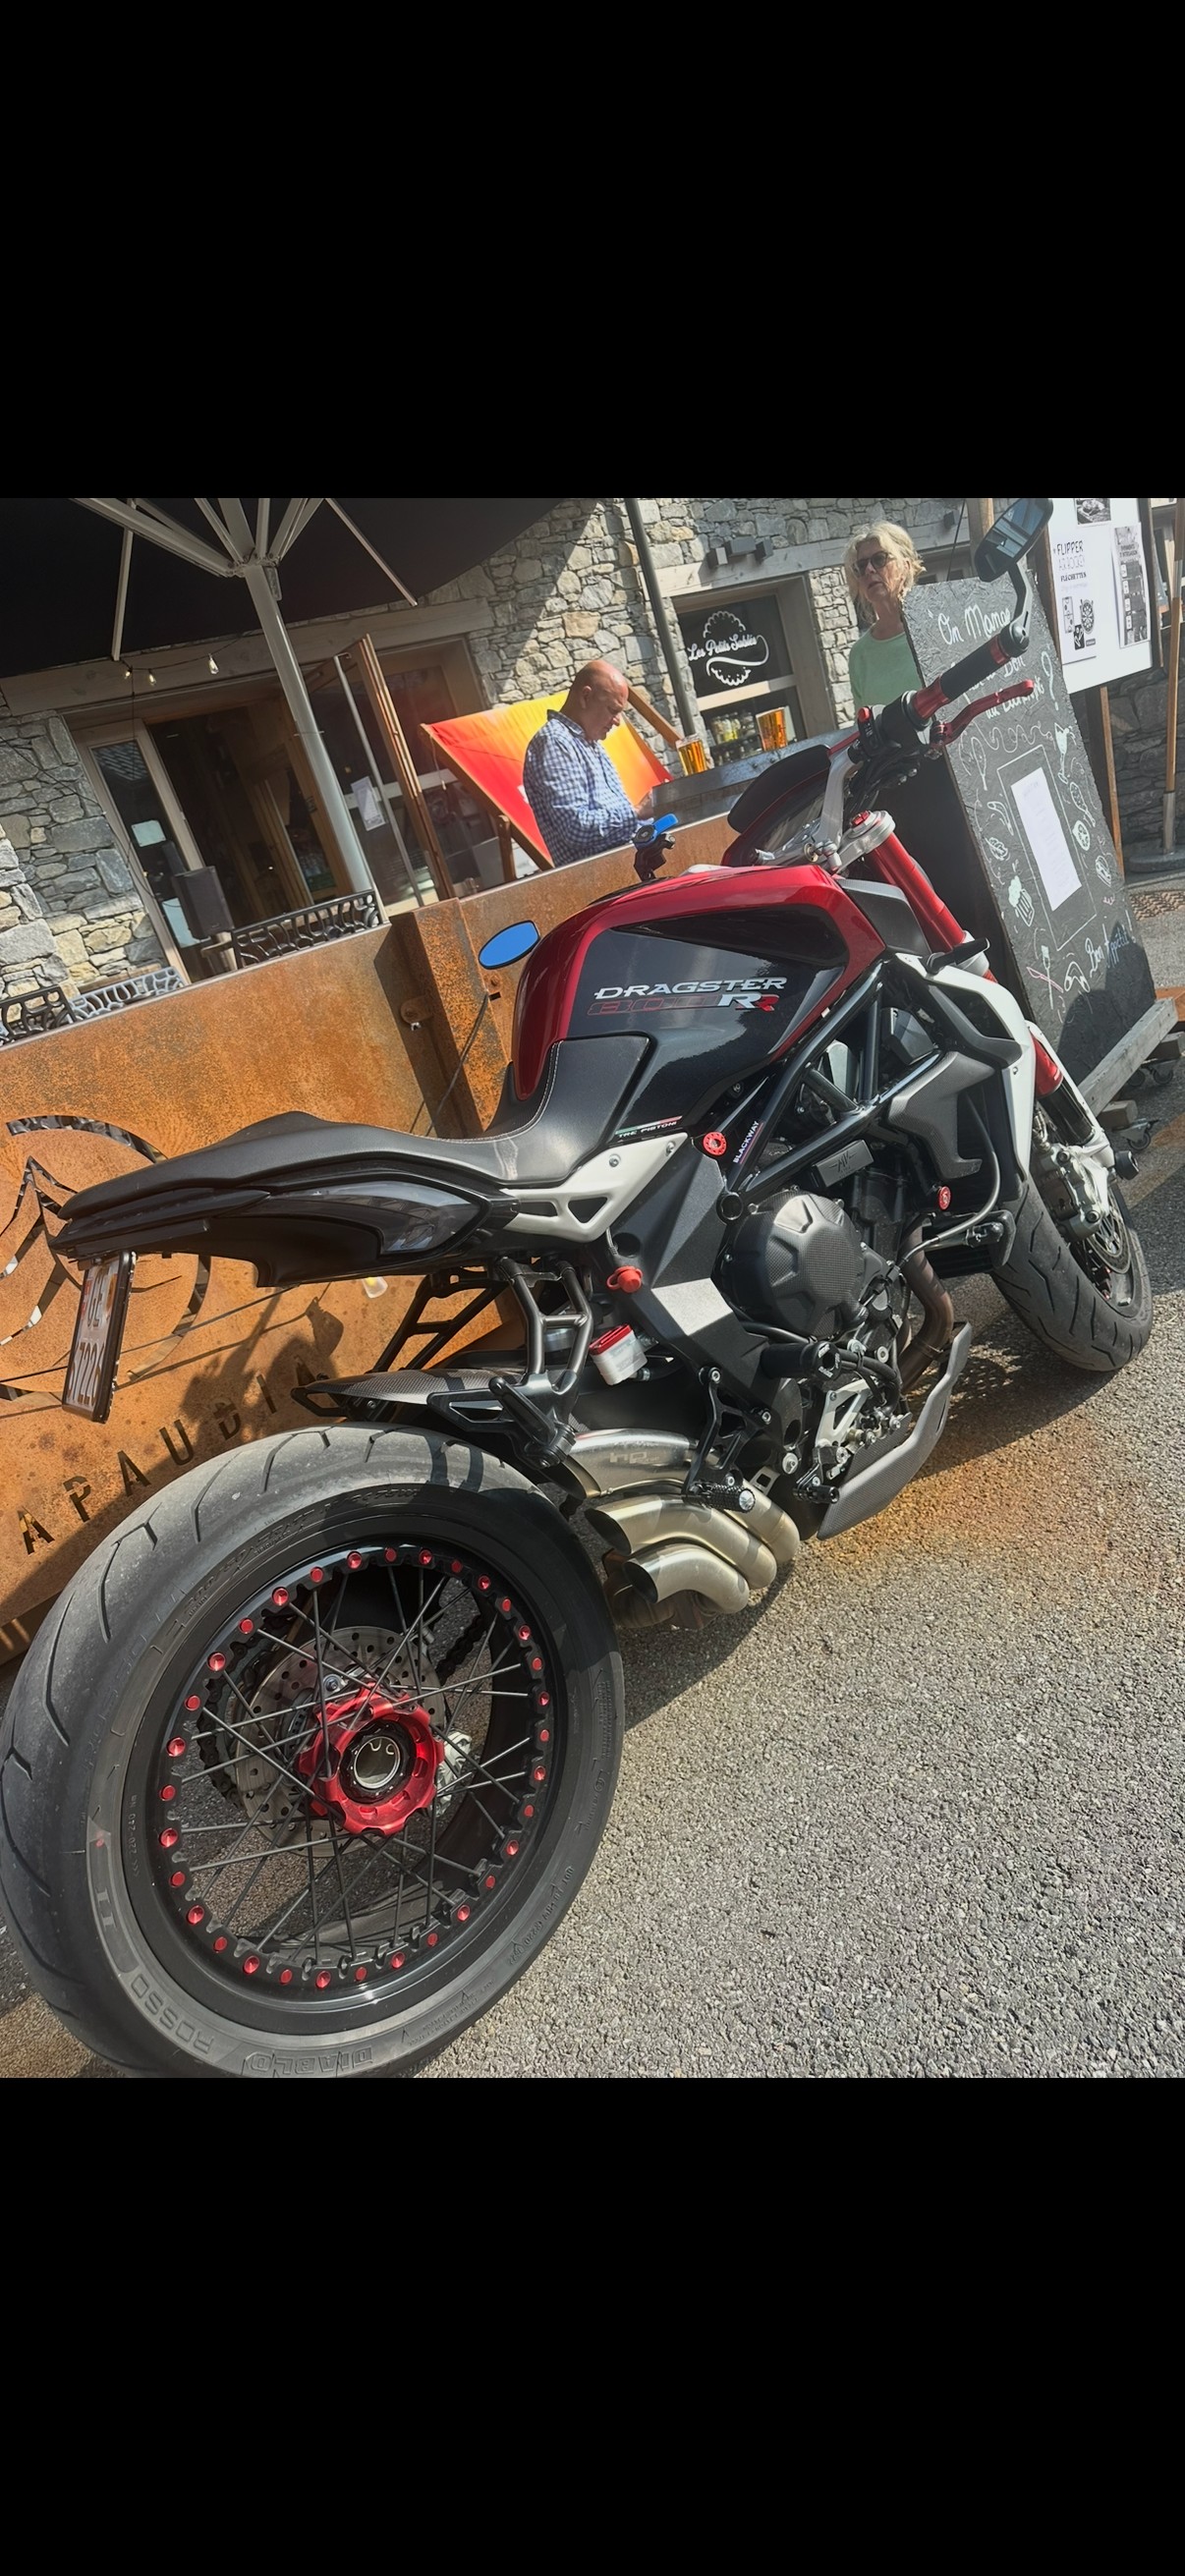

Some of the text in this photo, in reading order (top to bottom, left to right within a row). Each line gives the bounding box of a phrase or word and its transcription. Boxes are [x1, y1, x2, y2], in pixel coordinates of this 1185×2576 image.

[1056, 540, 1084, 555] FLIPPER
[687, 644, 705, 661] Les
[705, 640, 730, 656] Petits
[593, 977, 787, 1000] DRAGSTER
[732, 1120, 760, 1163] BLACKWAY
[131, 1973, 215, 2054] ROSSO
[247, 2044, 374, 2076] DIABLO
